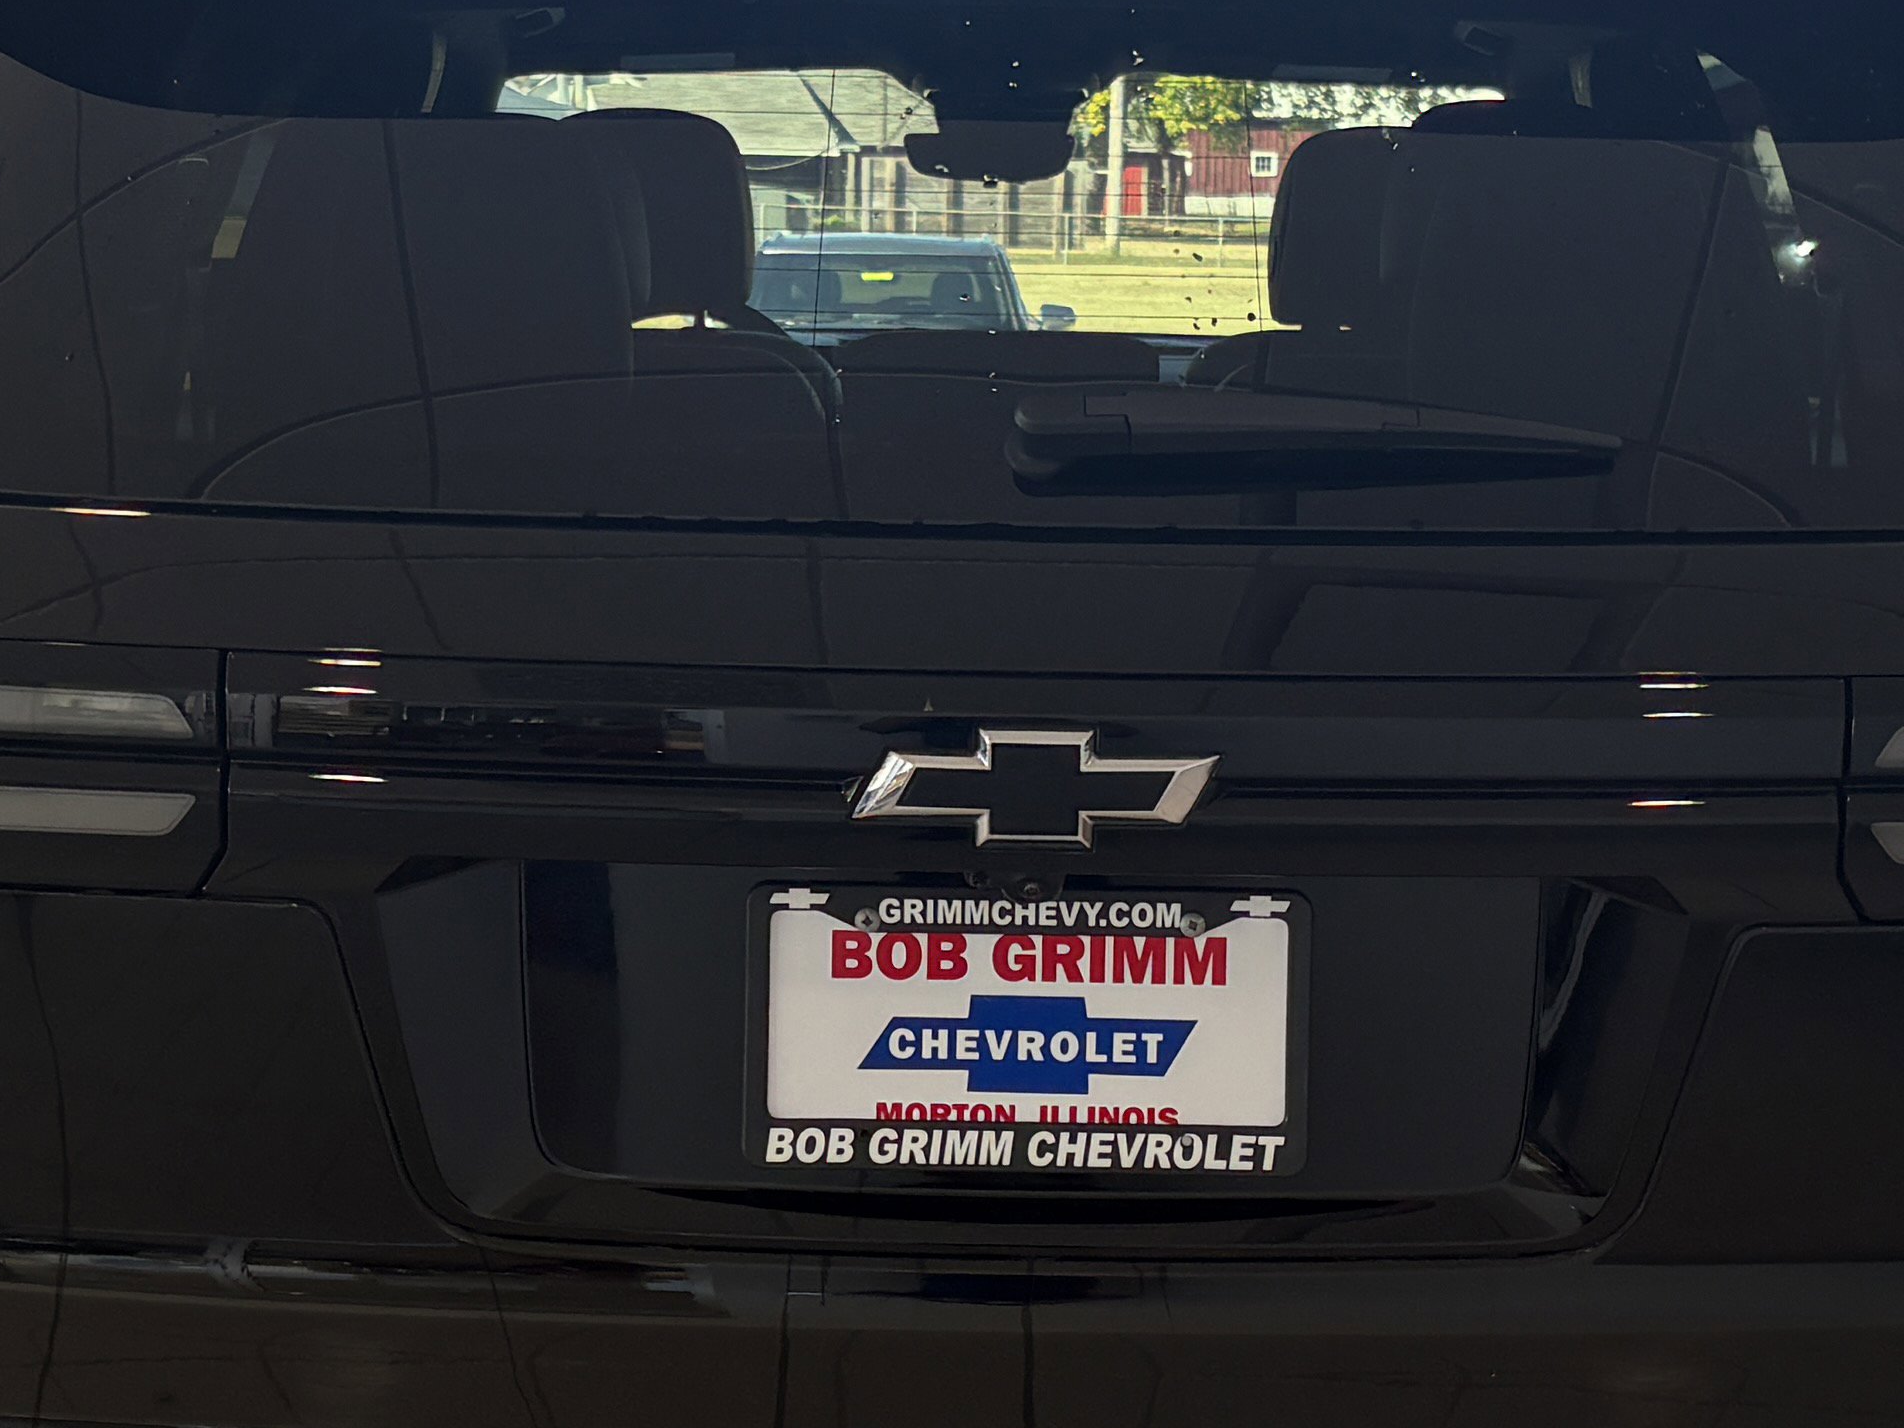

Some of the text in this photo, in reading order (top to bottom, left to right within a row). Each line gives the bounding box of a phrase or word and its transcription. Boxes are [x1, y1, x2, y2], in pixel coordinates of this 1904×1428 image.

[878, 898, 1183, 928] GRIMMCHEVY.COM
[831, 930, 1228, 986] BOB GRIMM
[888, 1028, 1164, 1064] CHEVROLET
[765, 1127, 1286, 1171] BOB GRIMM CHEVROLET
